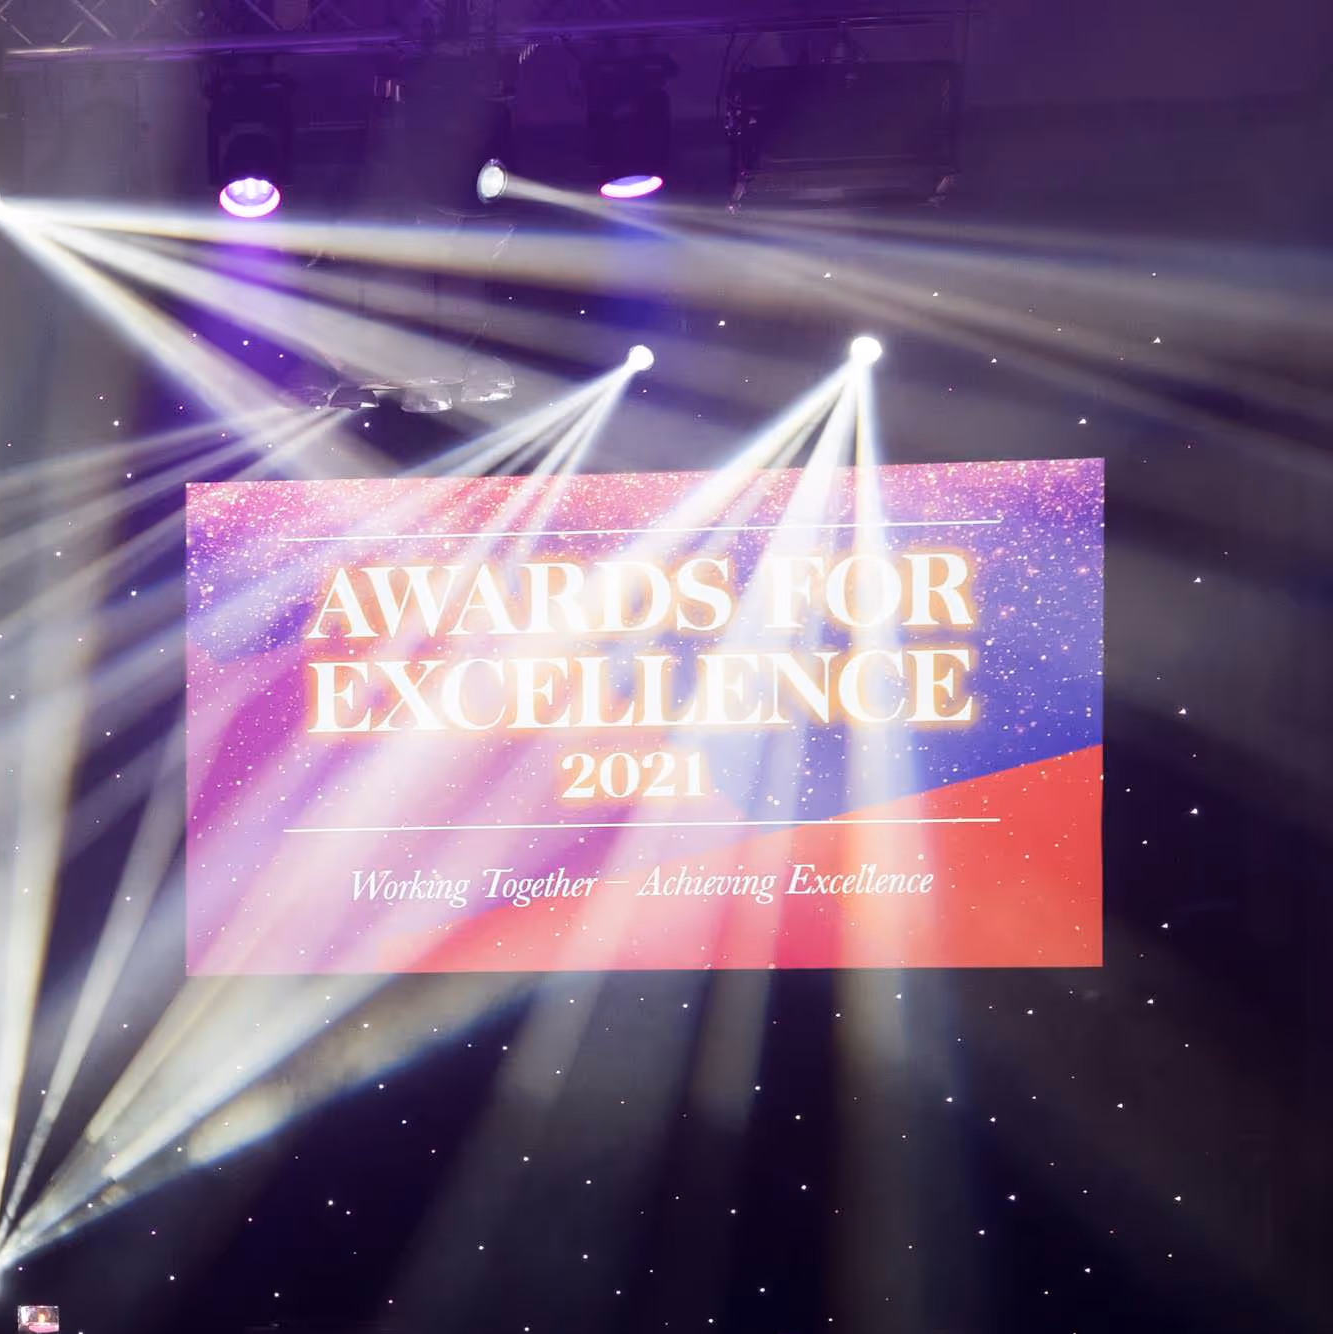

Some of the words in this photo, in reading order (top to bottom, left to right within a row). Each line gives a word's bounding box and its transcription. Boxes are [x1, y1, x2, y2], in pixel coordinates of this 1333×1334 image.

[306, 556, 732, 640] AWARDS
[764, 552, 974, 632] FOR
[307, 648, 974, 734] EXCELLENCE
[561, 751, 705, 800] 2021
[351, 869, 470, 907] Working
[481, 867, 599, 904] Together
[636, 865, 776, 903] Achieving
[784, 862, 935, 896] Excellence
